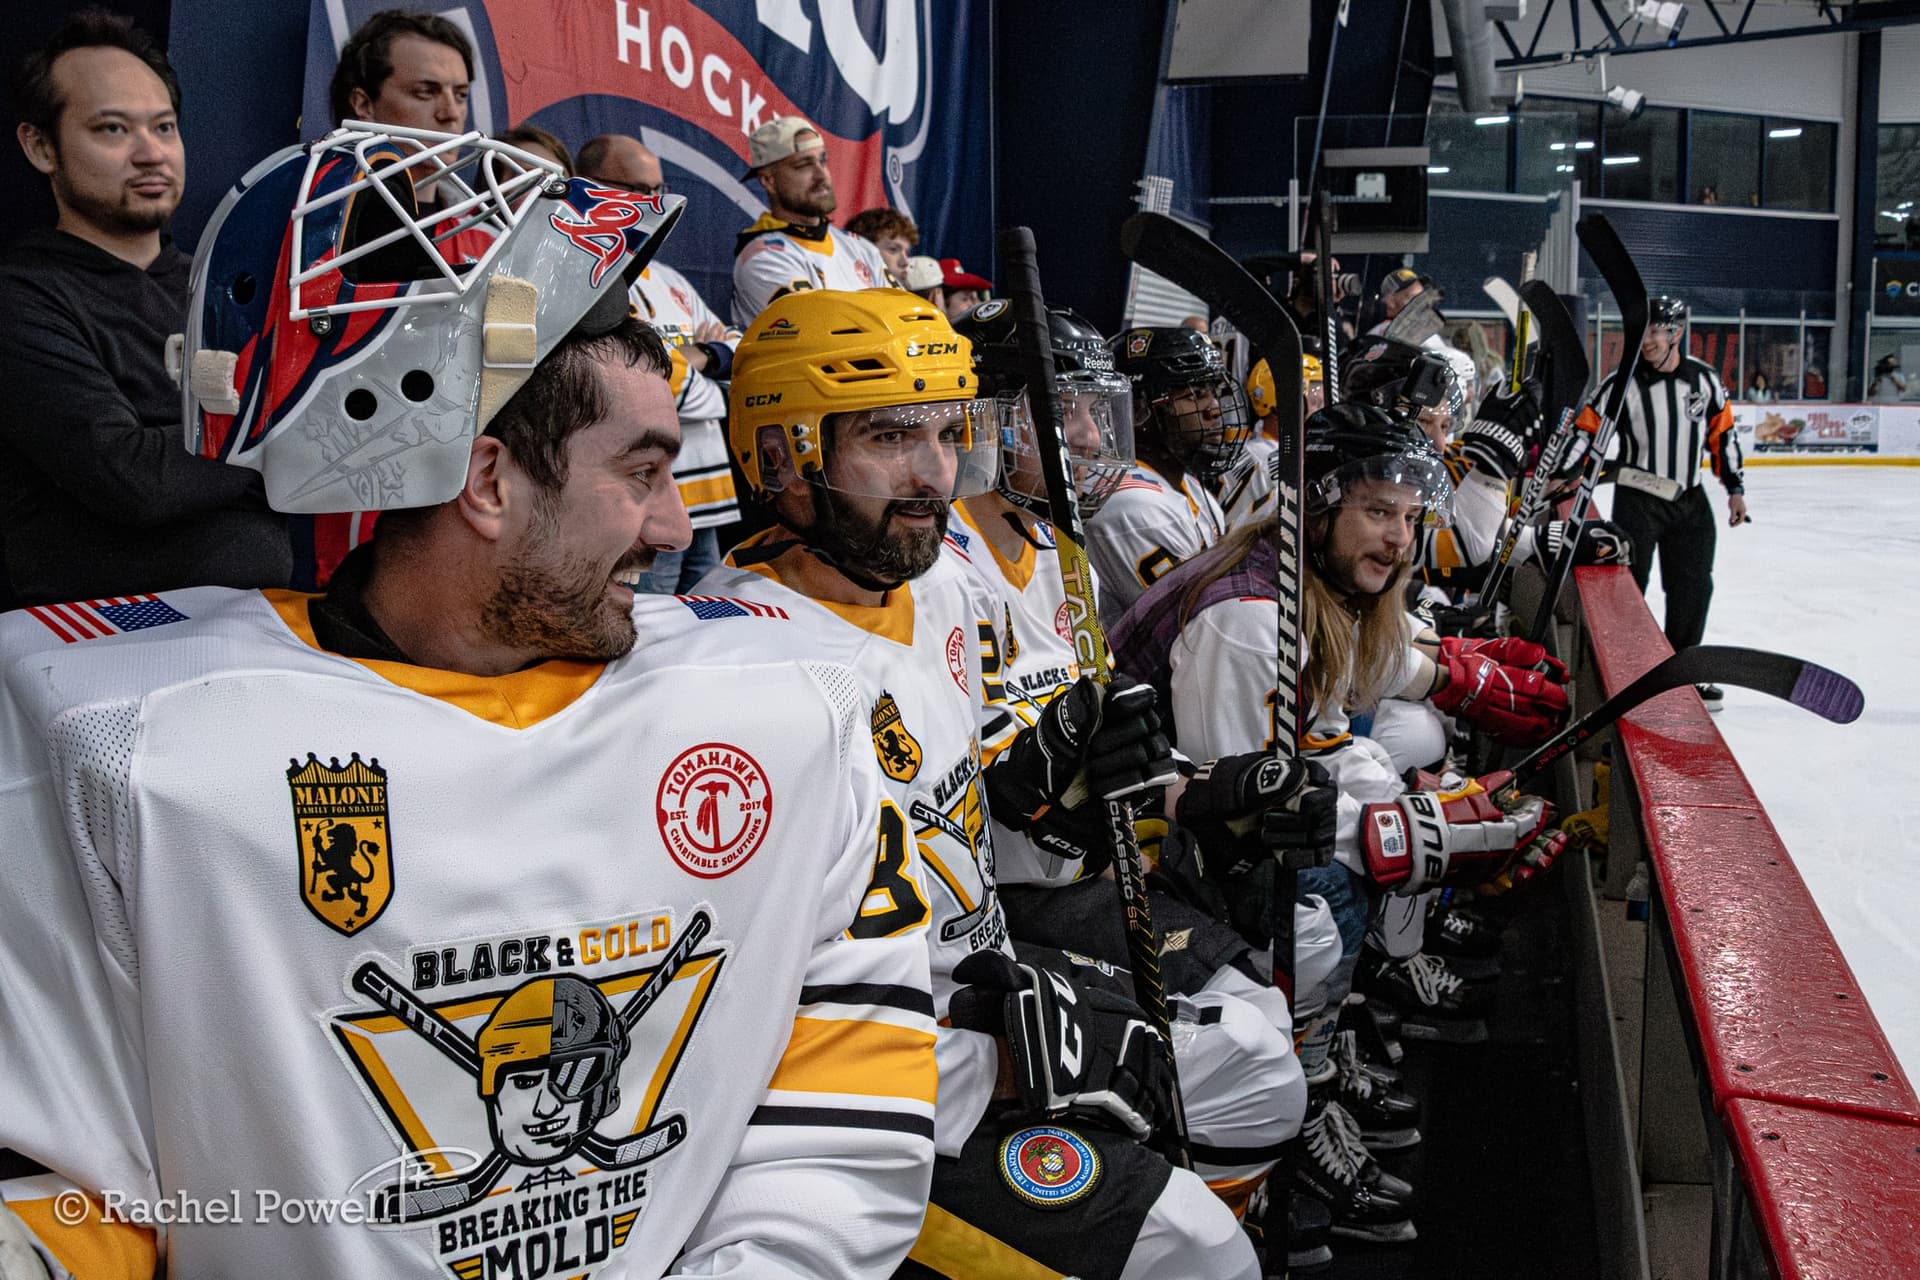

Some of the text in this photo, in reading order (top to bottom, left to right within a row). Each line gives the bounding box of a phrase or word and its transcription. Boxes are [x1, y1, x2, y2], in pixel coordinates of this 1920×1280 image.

[614, 0, 781, 137] HOCK
[906, 343, 958, 357] CCM
[1084, 356, 1114, 371] Reebok
[745, 392, 782, 408] CCM
[1558, 416, 1615, 555] TRUE
[1019, 668, 1058, 692] BLACK
[666, 752, 759, 795] TOMAHAWK
[294, 786, 385, 805] MALONE
[670, 800, 761, 821] EST. 2017
[670, 818, 762, 868] CHARITABLE SOLUTIONS
[1042, 834, 1084, 856] CCM
[1109, 800, 1134, 900] CLASSIC
[1127, 905, 1139, 931] SE
[412, 915, 671, 990] BLACK & GOLD
[438, 1168, 648, 1254] BREAKING THE
[485, 1214, 610, 1280] MOLD
